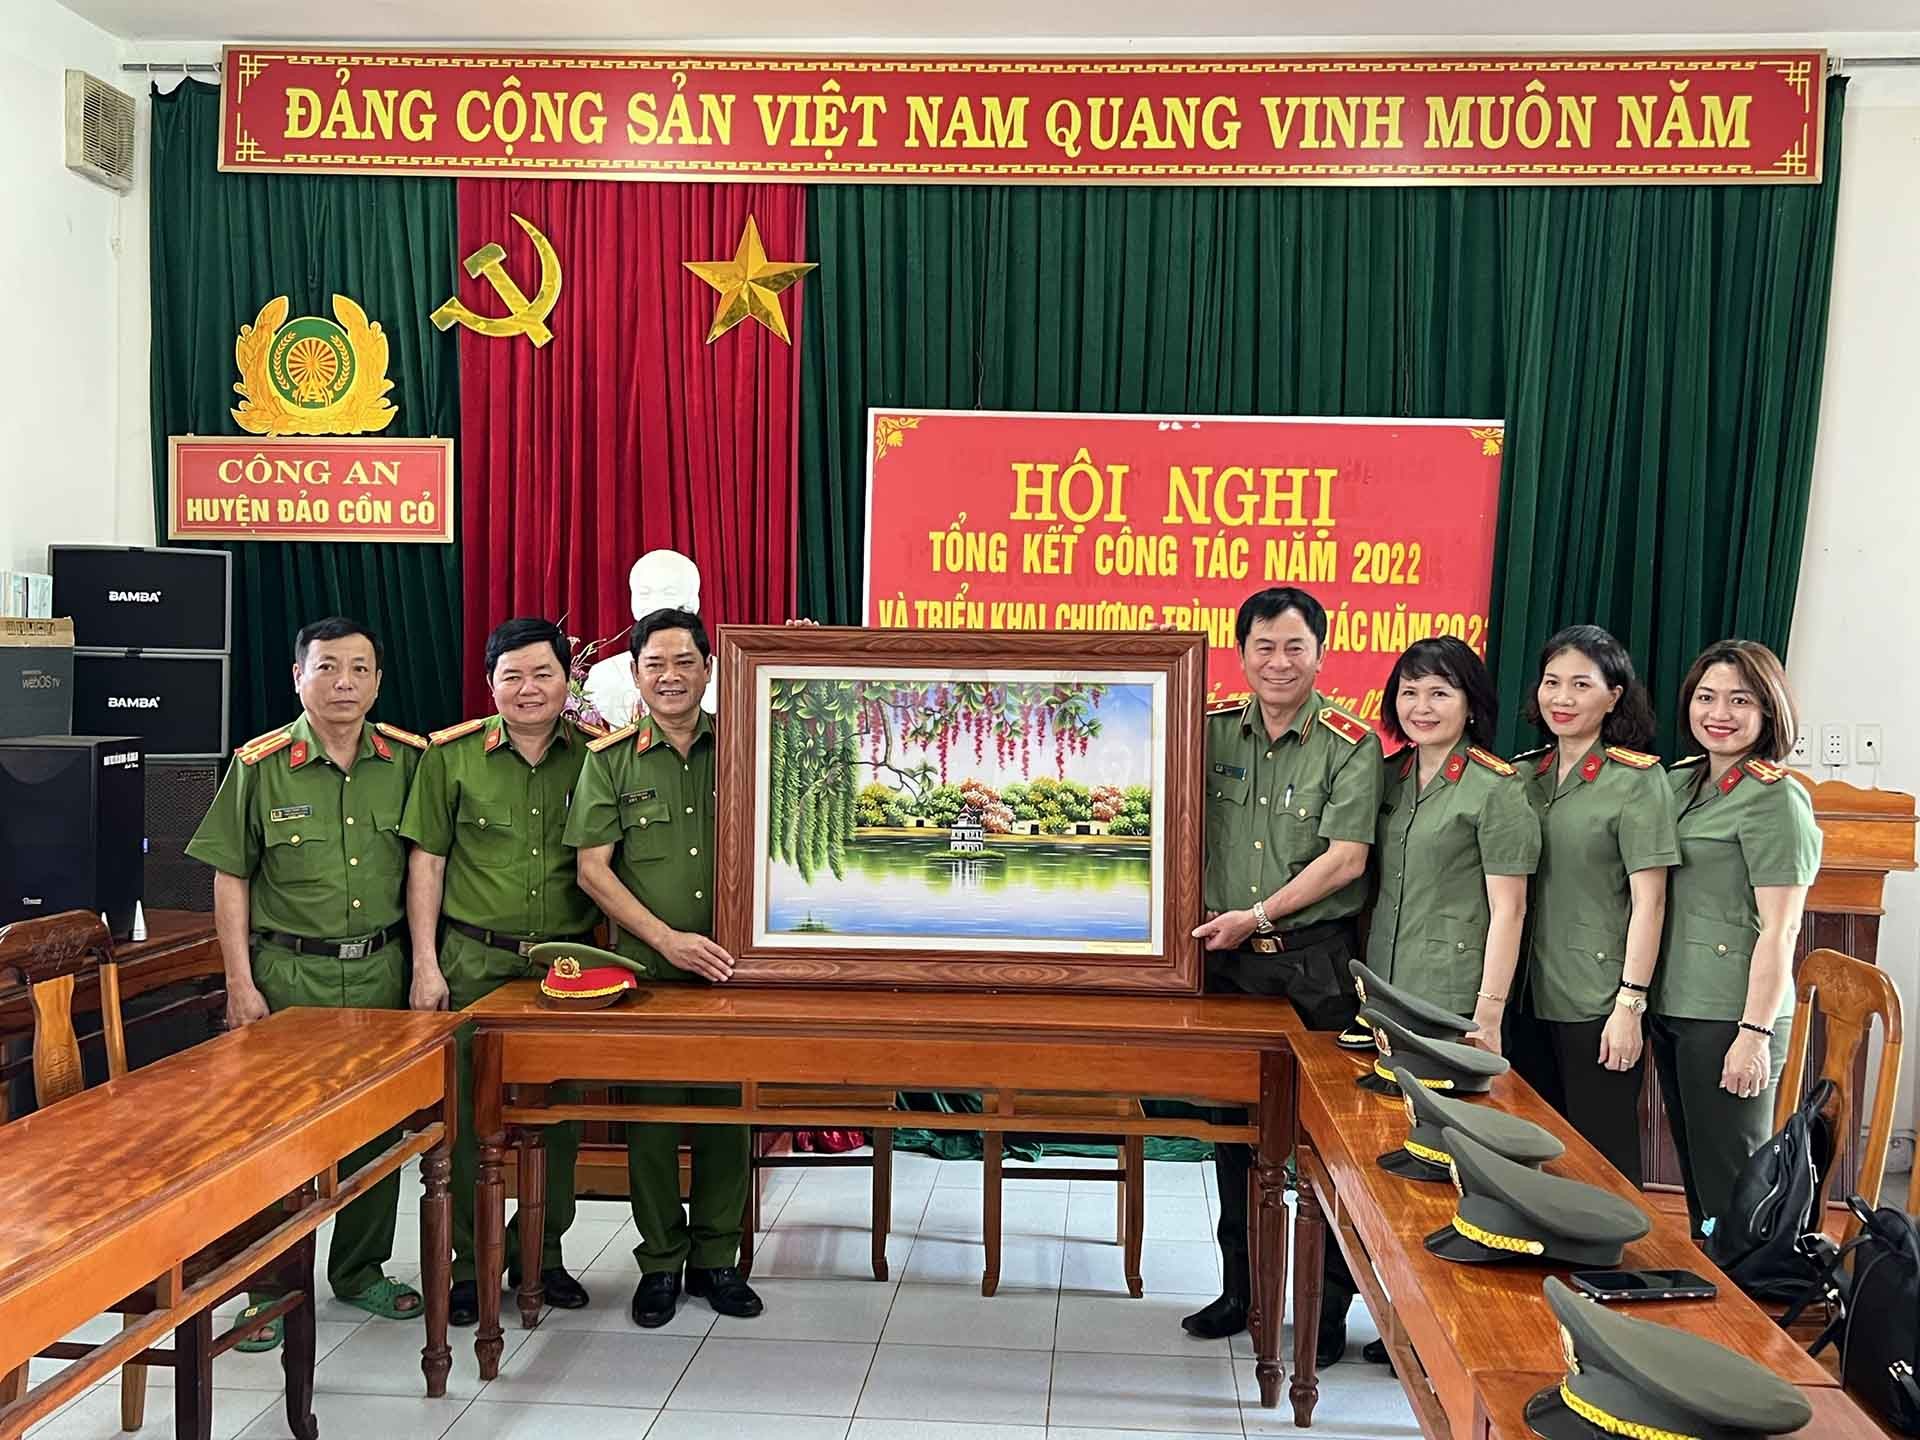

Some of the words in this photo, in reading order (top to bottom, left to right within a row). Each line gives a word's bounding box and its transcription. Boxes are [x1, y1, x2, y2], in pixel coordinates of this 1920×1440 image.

[284, 67, 437, 142] ĐẢNG
[456, 75, 608, 156] CỘNG
[626, 71, 736, 146] SẢN
[753, 79, 888, 161] VIỆT
[904, 95, 1029, 148] NAM
[1045, 95, 1242, 158] QUANG
[1260, 96, 1405, 150] VINH
[1423, 78, 1597, 150] MUÔN
[1615, 78, 1752, 149] NĂM
[218, 453, 332, 485] CÔNG
[342, 460, 402, 485] AN
[1009, 447, 1130, 534] HỘI
[1162, 466, 1338, 539] NGHỊ
[186, 494, 269, 527] HUYỆN
[277, 489, 329, 523] ĐẢO
[338, 491, 392, 524] CỒN
[400, 491, 435, 524] CỎ
[928, 511, 1007, 573] TỔNG
[1023, 524, 1078, 575] KẾT
[1094, 525, 1178, 577] CÔNG
[1192, 529, 1250, 580] TÁC
[1264, 531, 1337, 583] NĂM
[1351, 541, 1421, 585] 2022
[108, 591, 161, 603] BAMBA
[879, 591, 909, 628] VÀ
[914, 582, 985, 629] TRIỂN
[990, 602, 1047, 630] KHAI
[1371, 602, 1432, 653] NĂM
[1435, 612, 1488, 656] 202
[108, 696, 160, 708] BAMBA
